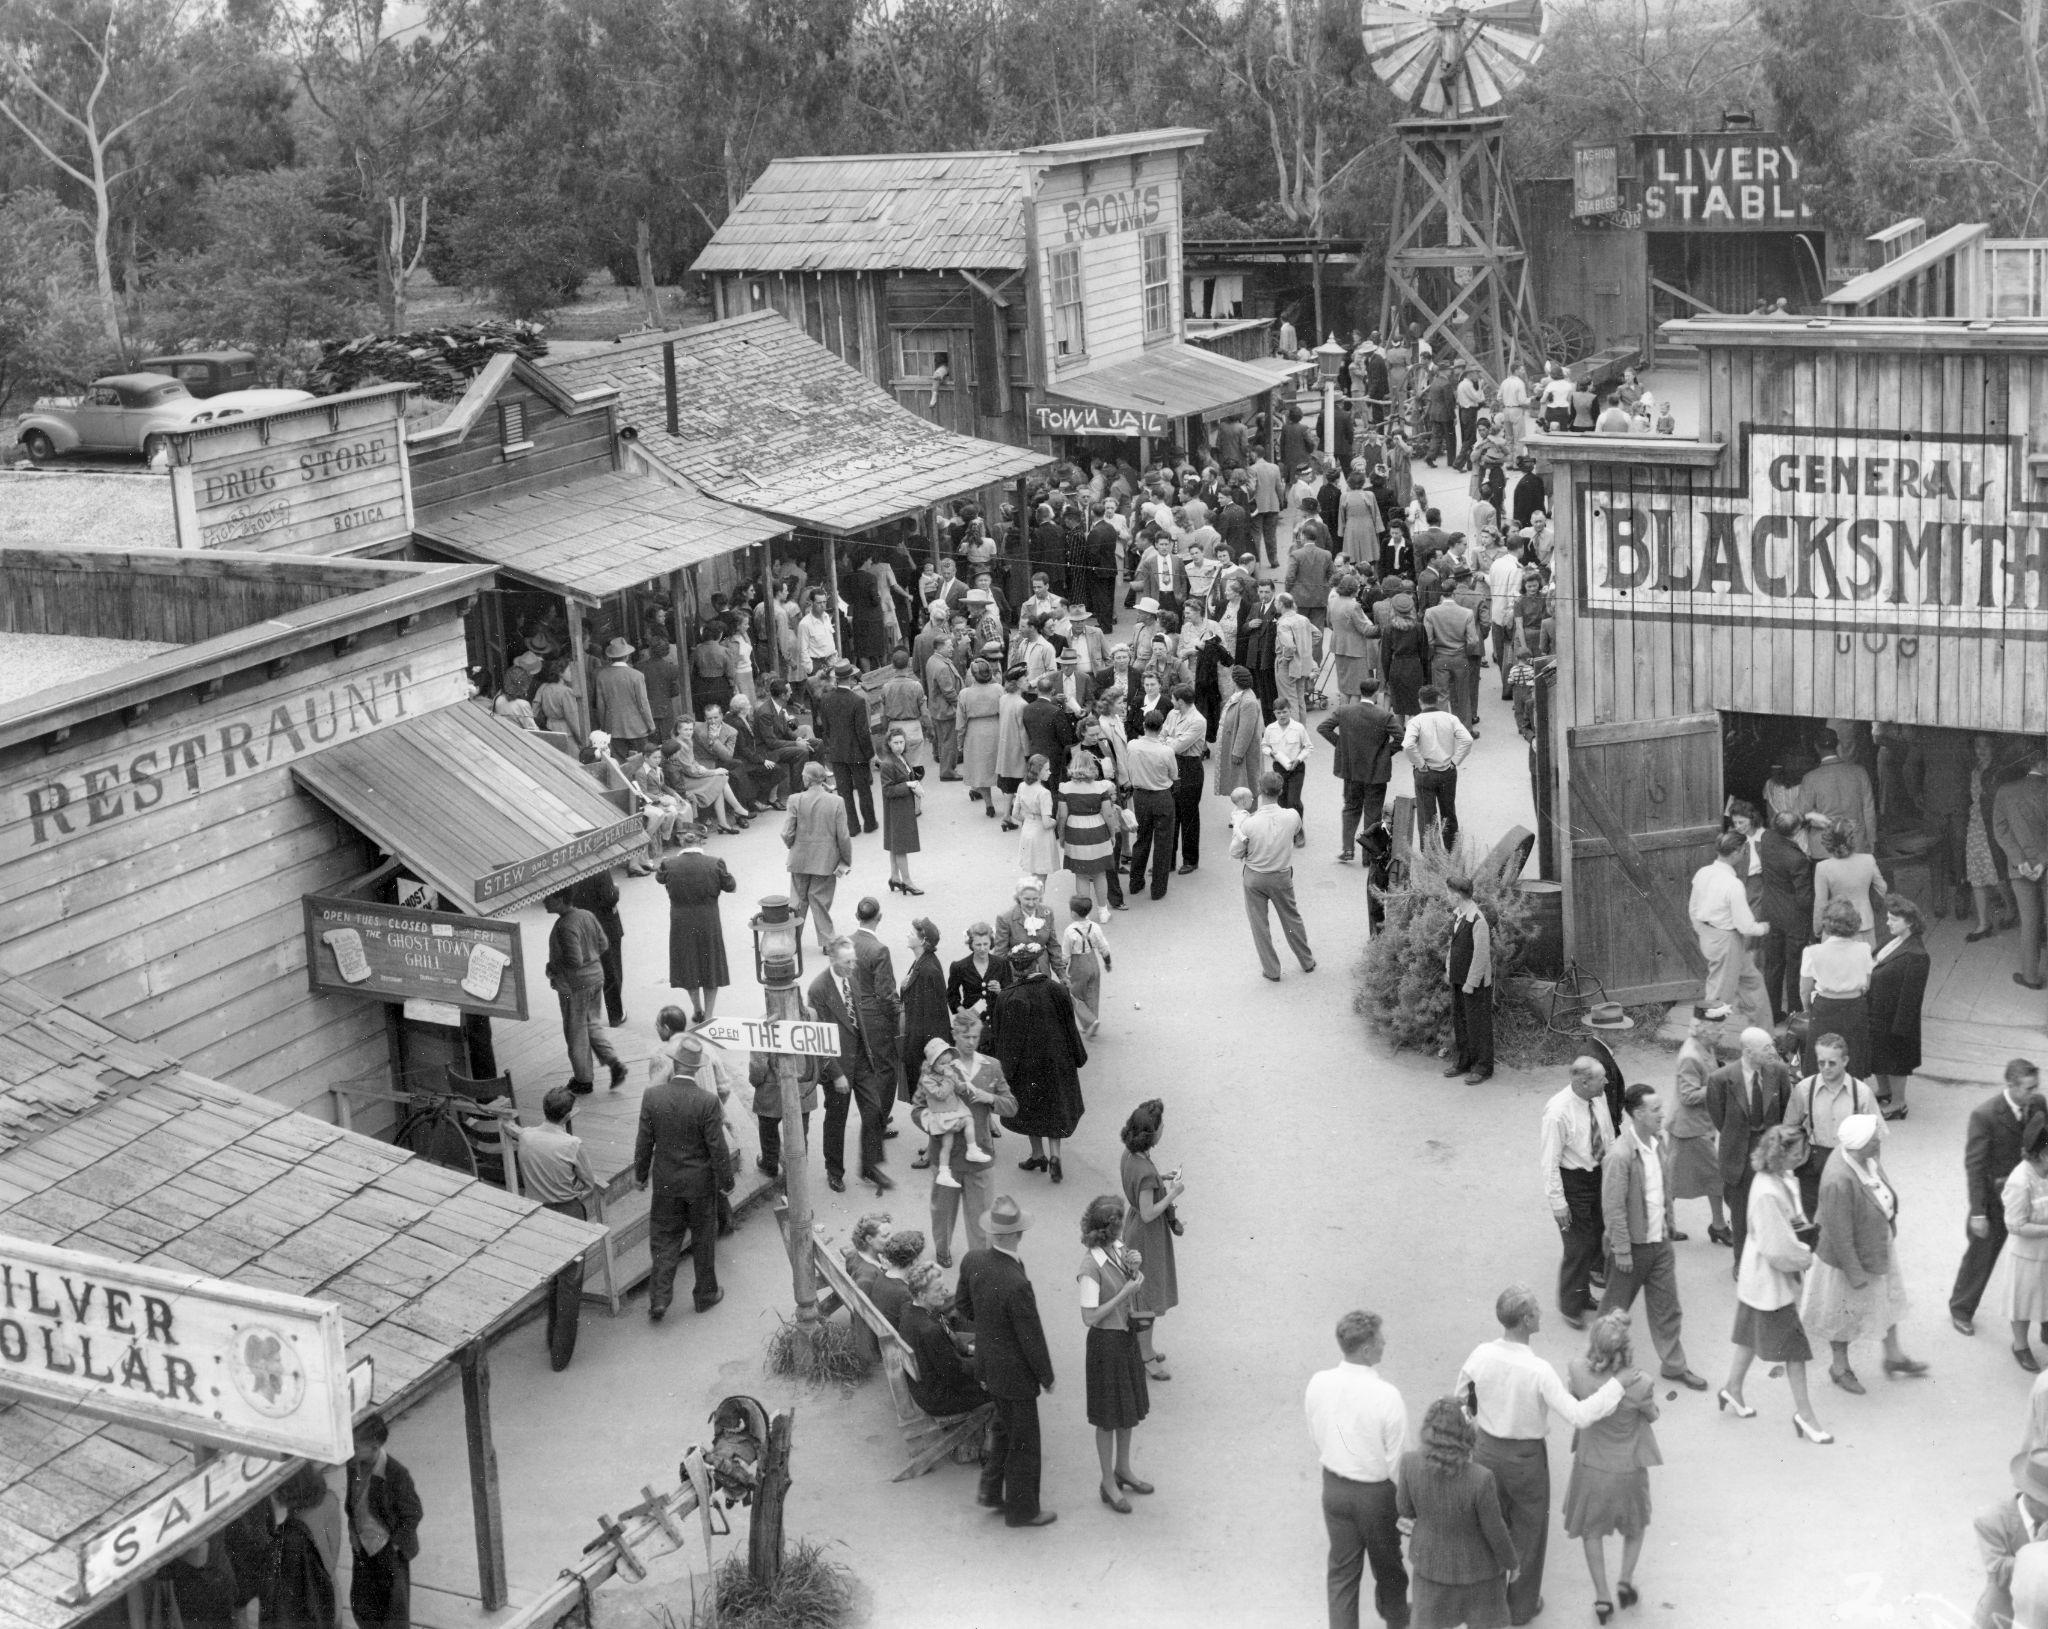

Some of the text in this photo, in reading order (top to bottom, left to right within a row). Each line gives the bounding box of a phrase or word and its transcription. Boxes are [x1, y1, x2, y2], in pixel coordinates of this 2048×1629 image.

[1577, 147, 1616, 164] FASHION
[1657, 145, 1801, 181] LIVERY
[1062, 185, 1160, 243] ROOMS
[1577, 196, 1616, 212] STABLES
[1036, 407, 1099, 430] TOWN
[204, 438, 387, 504] DRUG STORE
[1768, 453, 1995, 502] GENERAL
[333, 506, 385, 531] BOTICA
[1600, 506, 2048, 611] BLACKSMITH
[22, 663, 413, 847] RESTRAUNT
[484, 866, 525, 896] STEW
[531, 859, 548, 873] AND
[552, 837, 592, 867] STEAK
[604, 816, 644, 846] FEATURES
[323, 910, 350, 922] OPEN
[388, 918, 428, 933] CLOSED
[366, 930, 471, 957] THE GHOST TOWN
[404, 952, 440, 970] GRILL
[708, 1022, 838, 1055] OPEN THE GRILL
[0, 1263, 180, 1346] ILVER
[0, 1318, 203, 1405] OLLAR
[113, 1452, 272, 1567] SALO
